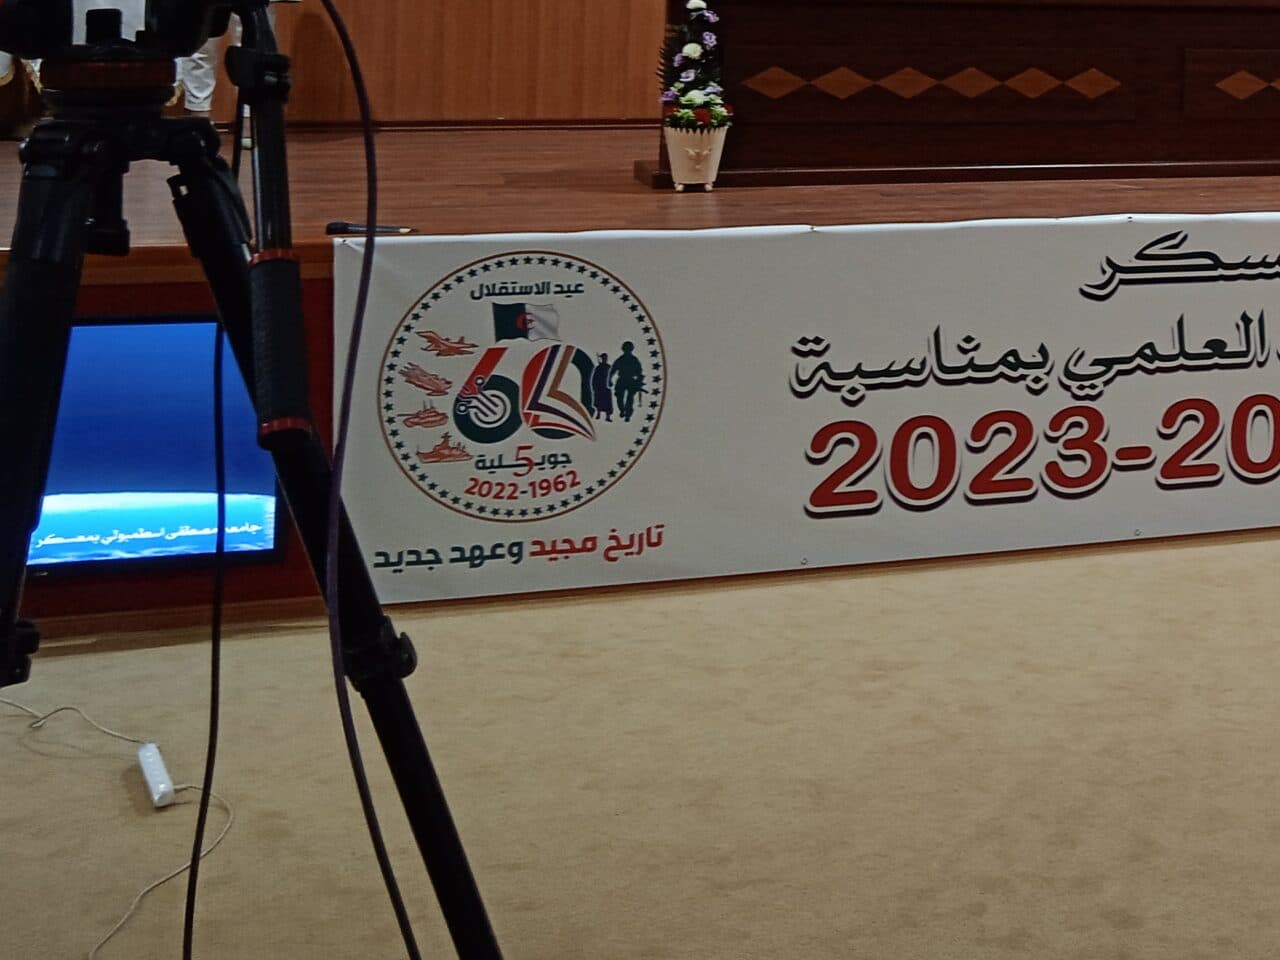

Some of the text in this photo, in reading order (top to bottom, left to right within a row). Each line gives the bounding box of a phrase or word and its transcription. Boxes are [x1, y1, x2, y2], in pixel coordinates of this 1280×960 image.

[470, 281, 584, 300] عيد الاستقلال
[790, 324, 1053, 406] بمناسبة
[1059, 309, 1269, 401] العلمي
[373, 524, 665, 574] تاريخ مجيد وعهد جديد
